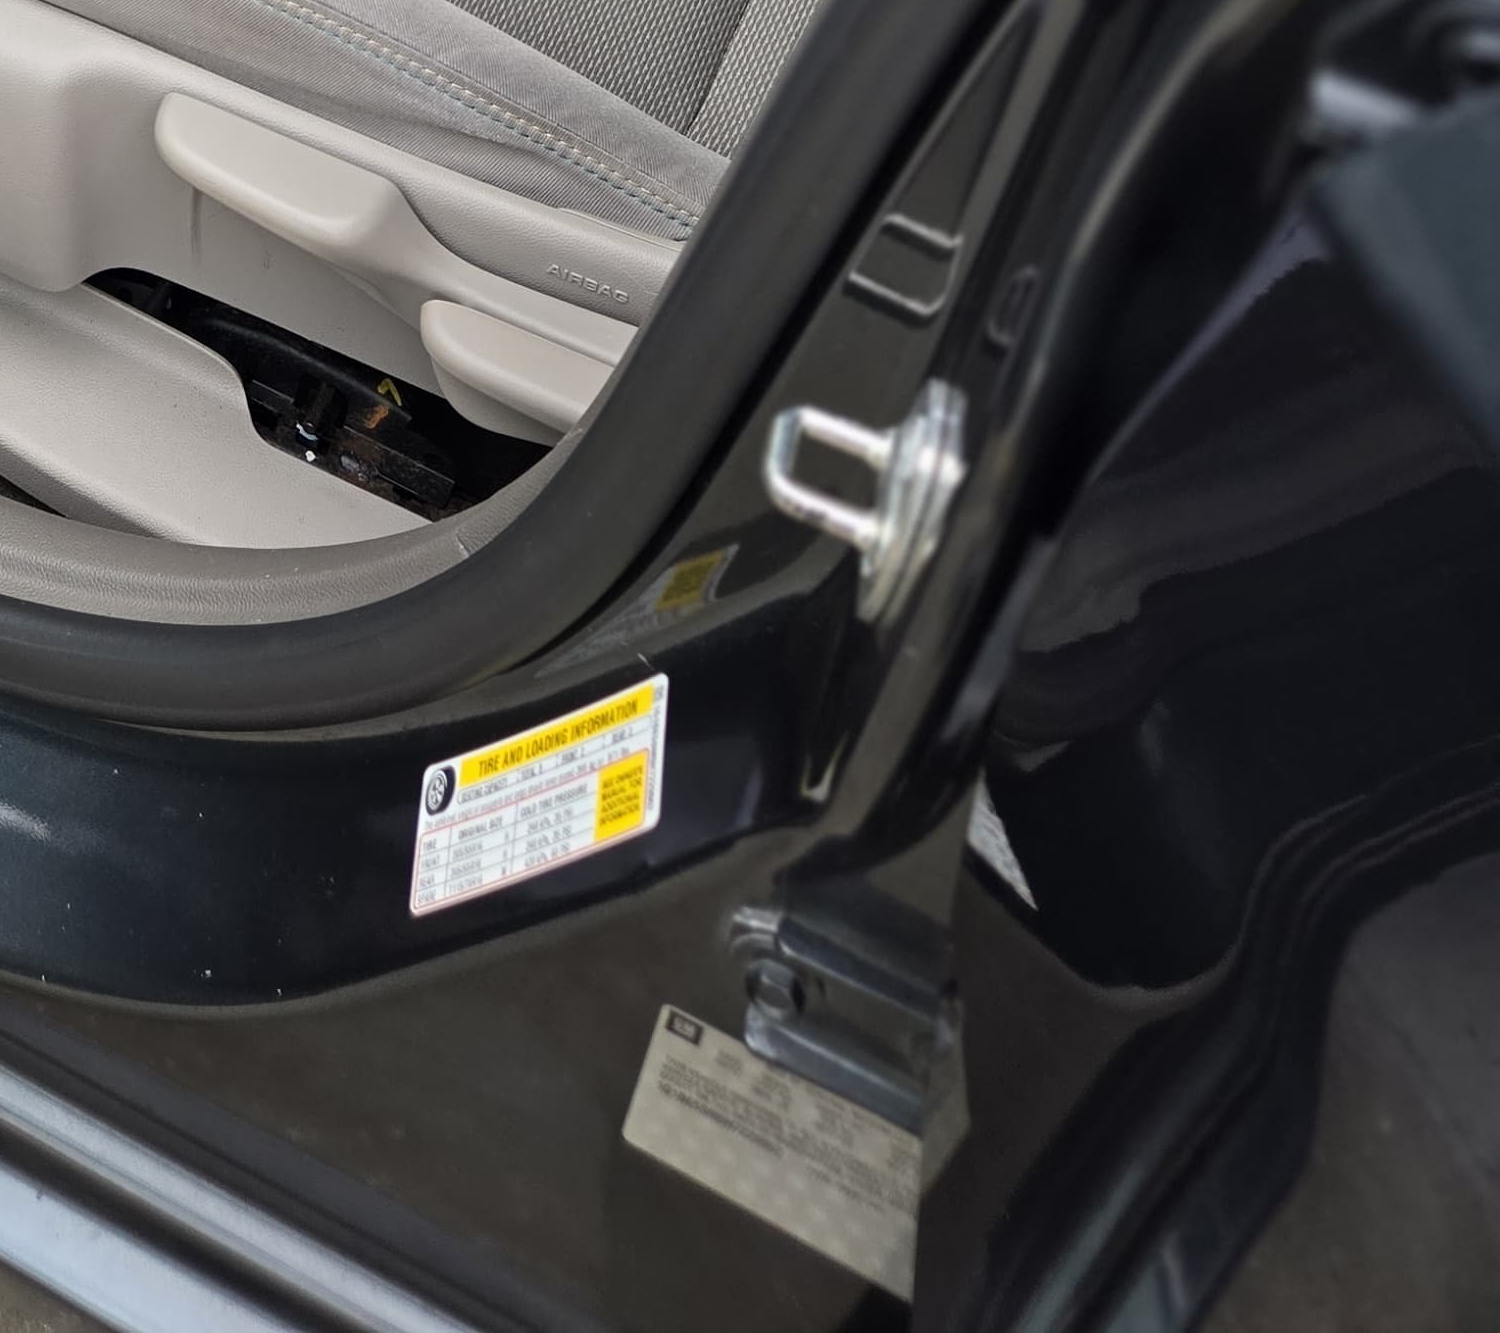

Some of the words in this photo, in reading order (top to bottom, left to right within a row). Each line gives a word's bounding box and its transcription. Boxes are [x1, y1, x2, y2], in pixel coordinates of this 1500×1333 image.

[546, 263, 630, 304] AIRBAG
[478, 754, 500, 778] TIRE
[501, 746, 523, 769] AND
[526, 726, 569, 759] LOADING
[569, 698, 638, 743] INFORMATION
